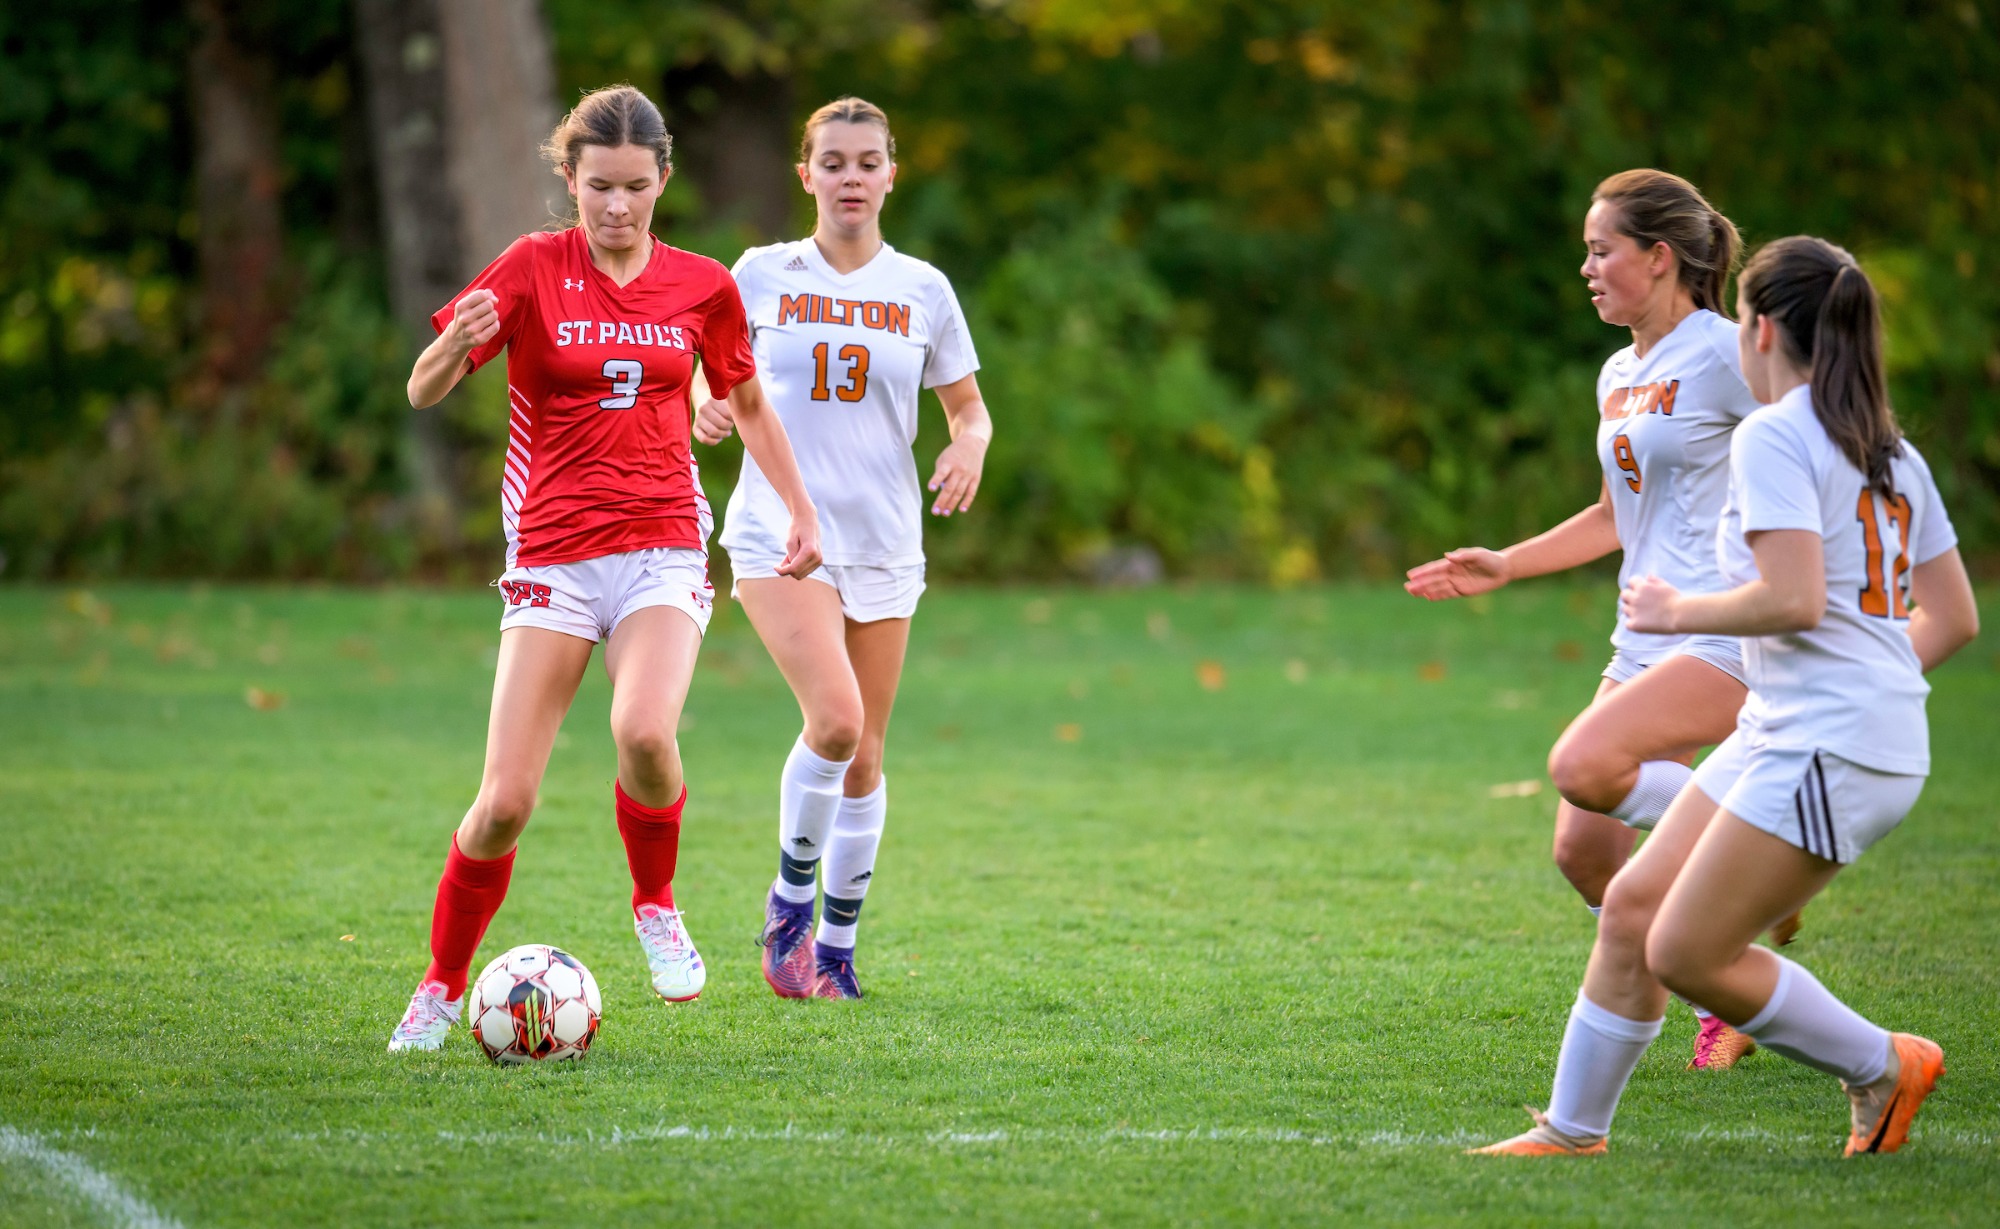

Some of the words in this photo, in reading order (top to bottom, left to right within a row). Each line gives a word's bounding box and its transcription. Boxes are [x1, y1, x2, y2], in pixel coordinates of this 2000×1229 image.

[556, 319, 594, 347] ST.
[598, 321, 686, 351] PAUL'S
[777, 293, 911, 338] MILTON
[598, 358, 644, 411] 3
[811, 342, 870, 403] 13
[1613, 434, 1643, 494] 9
[1856, 485, 1913, 620] 12
